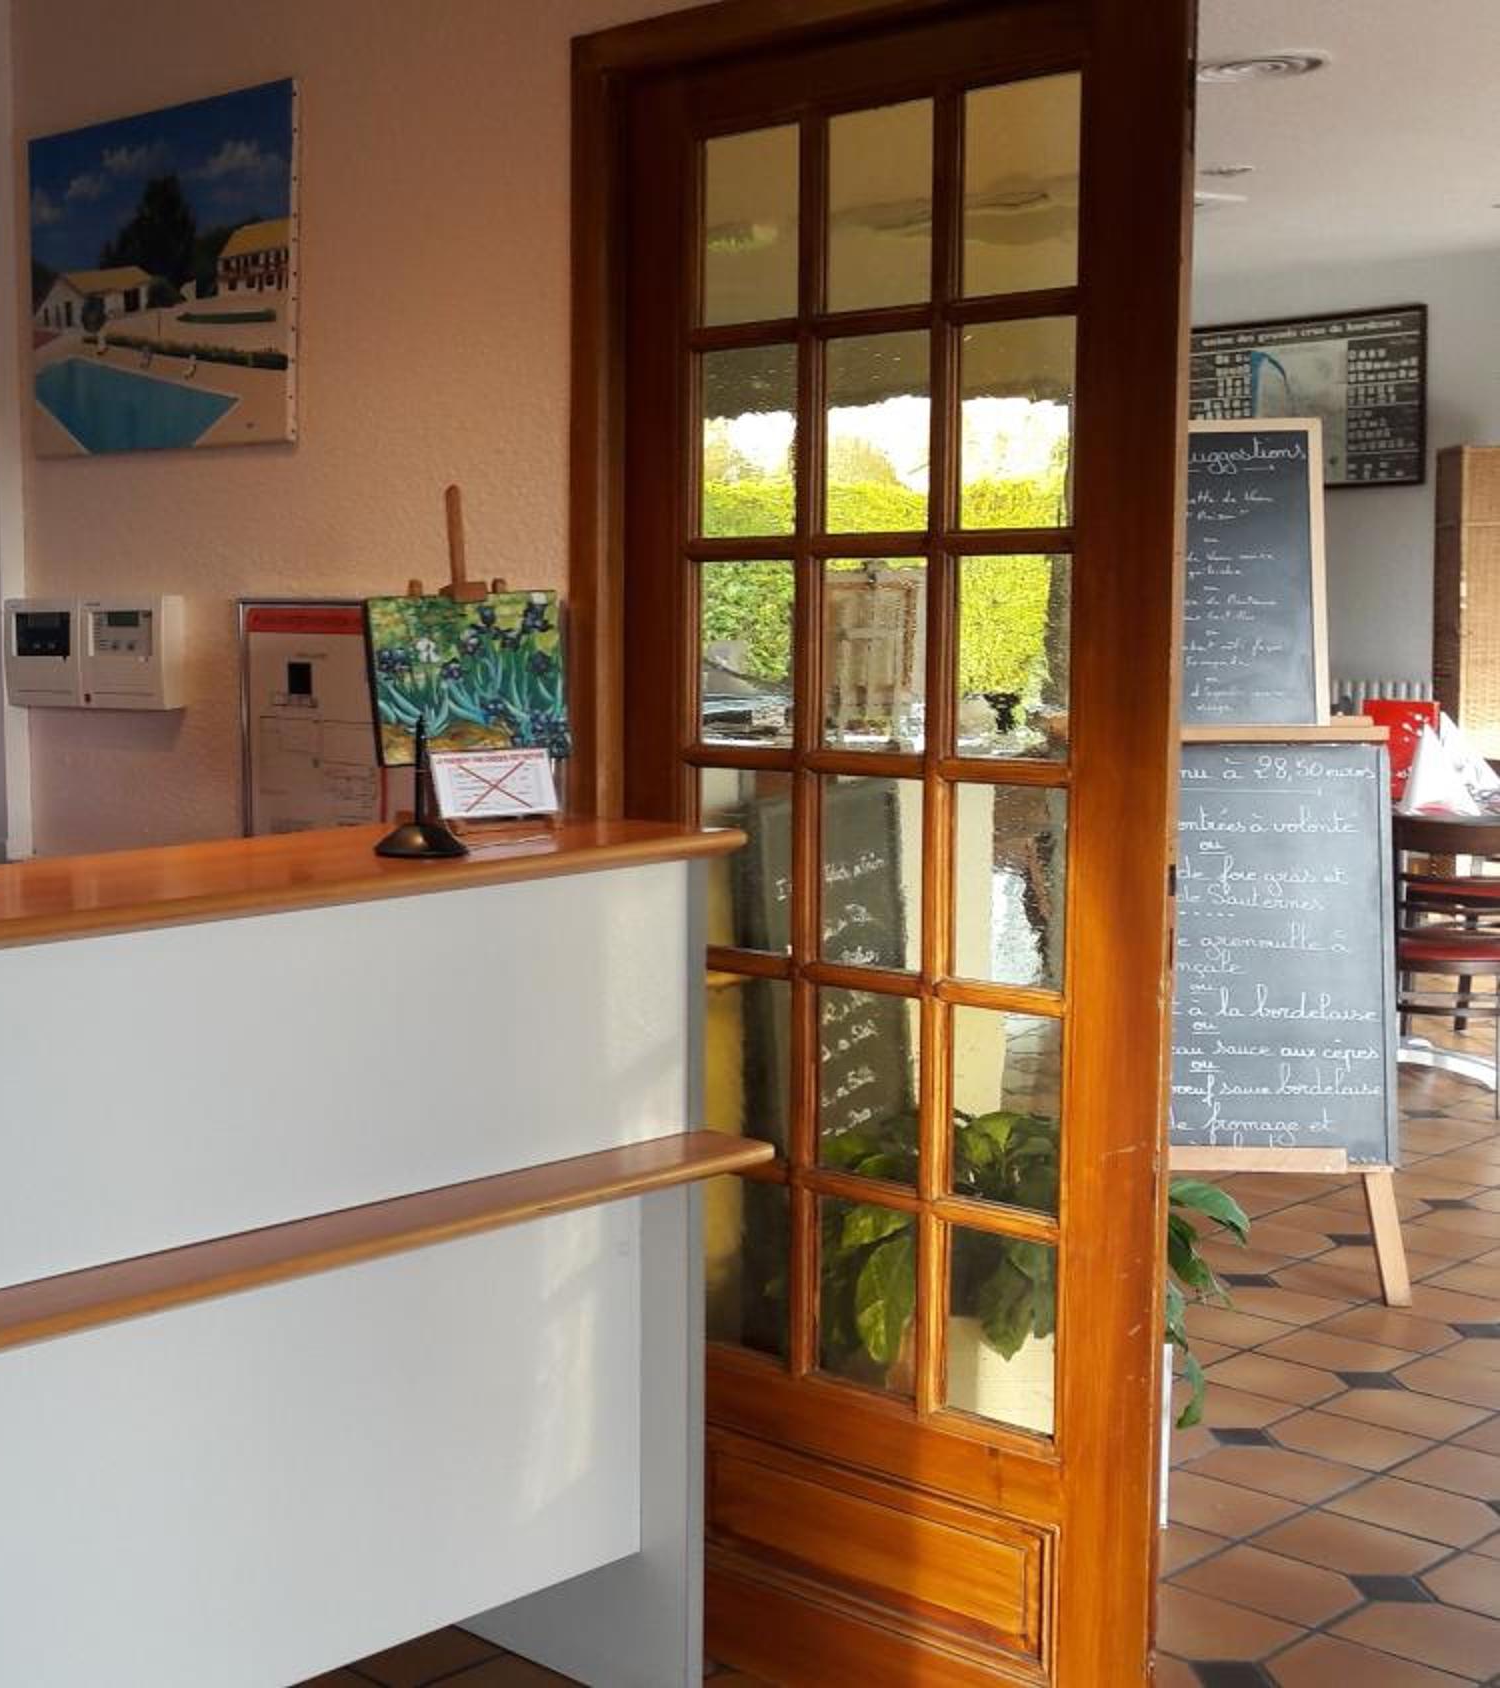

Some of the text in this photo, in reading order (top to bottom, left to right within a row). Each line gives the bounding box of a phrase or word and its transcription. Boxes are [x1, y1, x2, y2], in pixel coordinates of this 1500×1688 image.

[1188, 437, 1306, 474] uggestions
[1179, 767, 1211, 779] nu
[1272, 804, 1361, 833] volonté
[1178, 948, 1247, 979] nçale
[1214, 985, 1246, 1017] la
[1248, 983, 1380, 1022] bordelaise
[1280, 1046, 1317, 1058] aux
[1275, 1062, 1381, 1096] bordelaise
[1201, 1101, 1301, 1147] fromage
